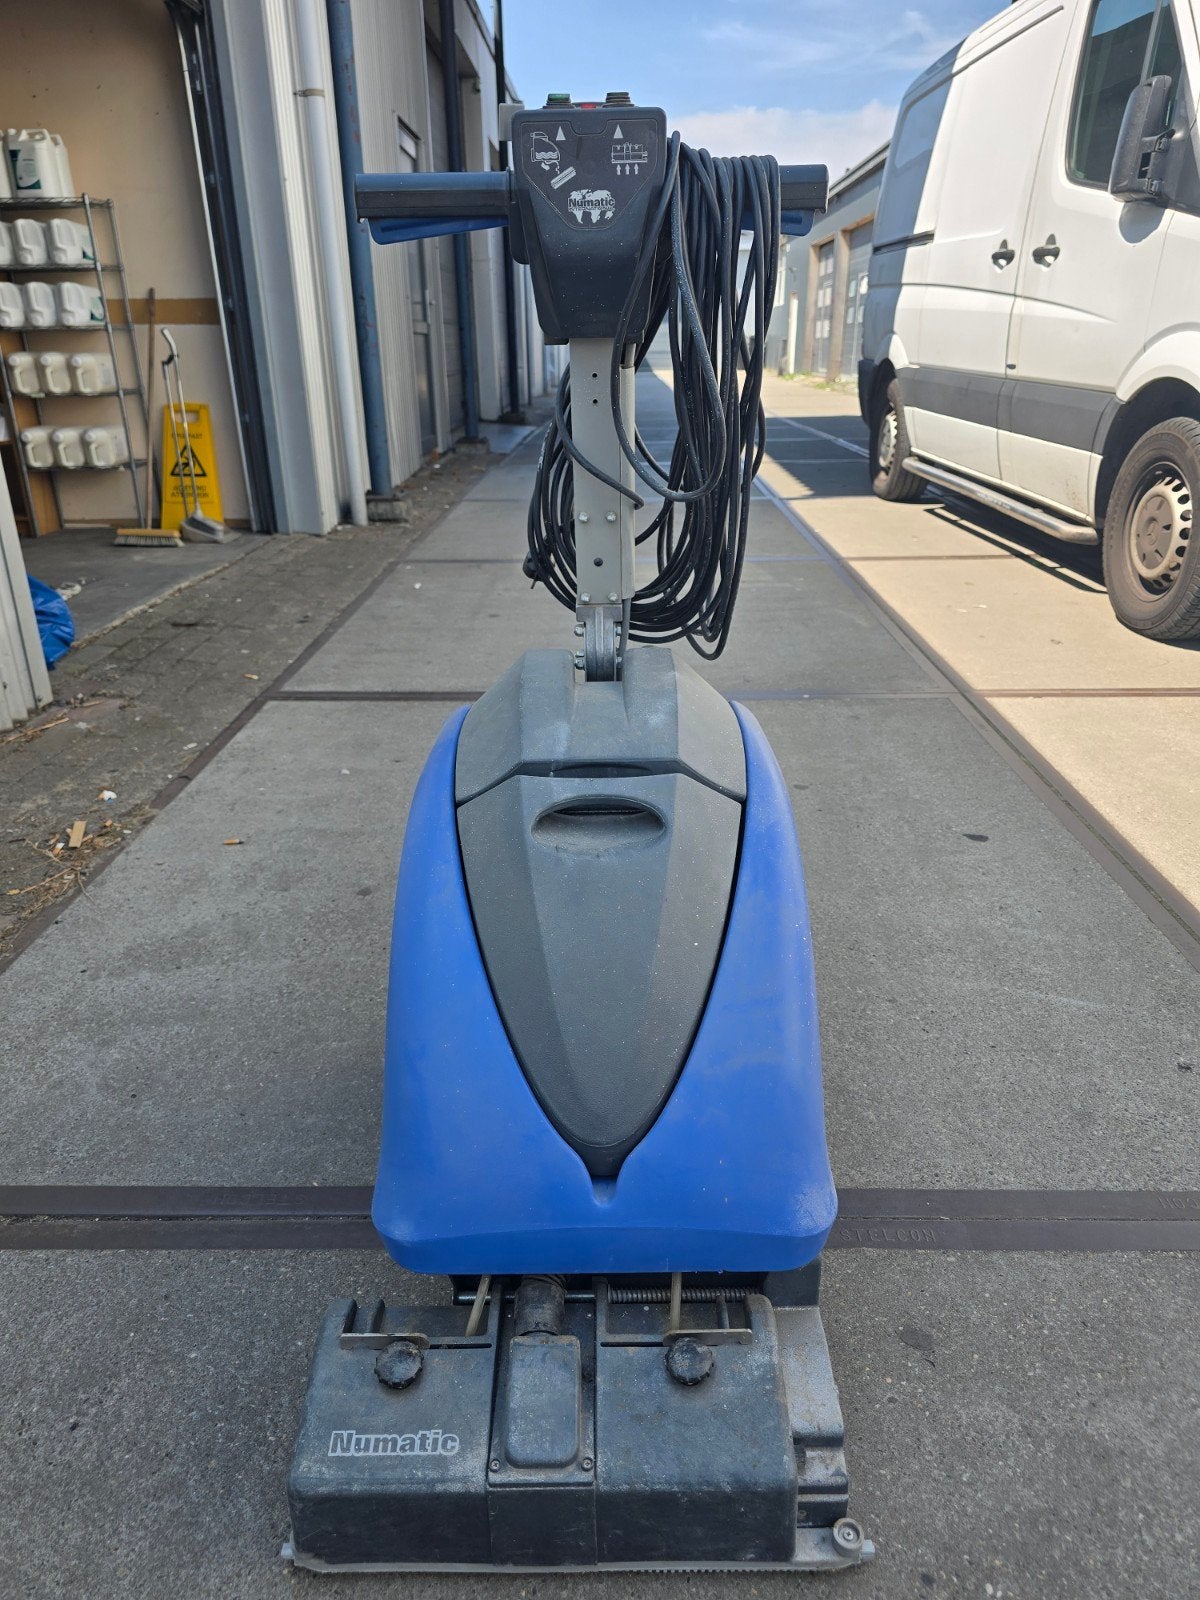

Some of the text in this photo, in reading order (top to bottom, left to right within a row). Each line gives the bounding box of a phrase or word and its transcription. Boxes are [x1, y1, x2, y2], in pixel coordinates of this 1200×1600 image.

[567, 197, 615, 207] Numatic
[840, 1228, 936, 1241] STELCON
[328, 1430, 460, 1456] Numatic
